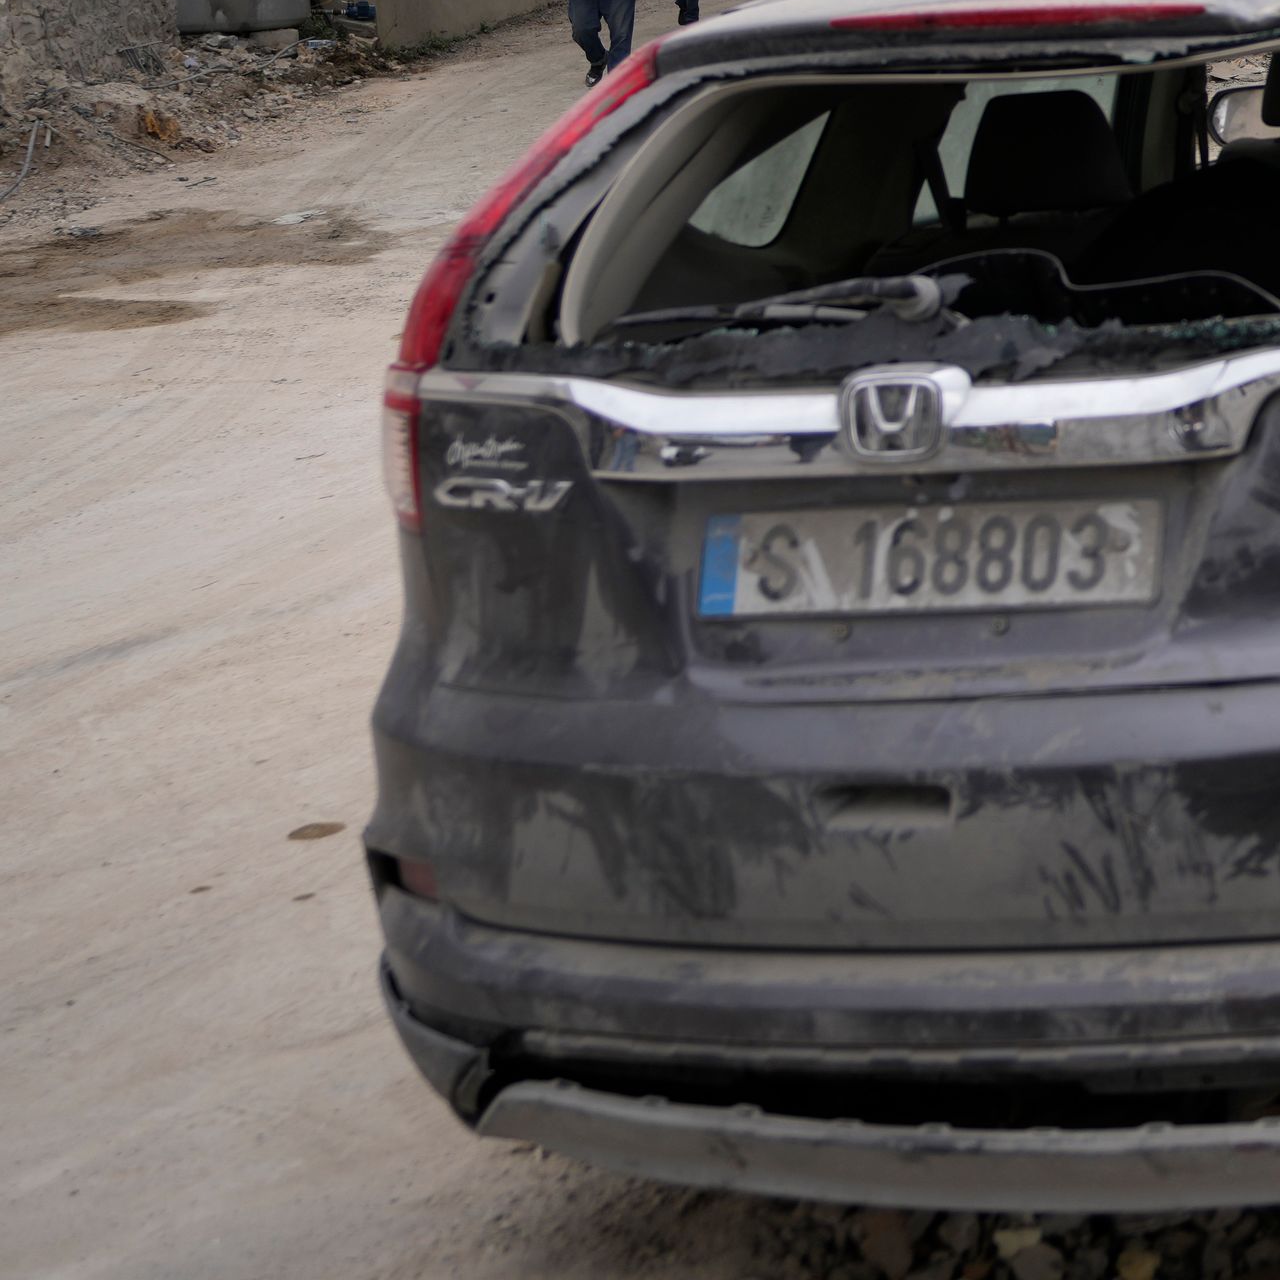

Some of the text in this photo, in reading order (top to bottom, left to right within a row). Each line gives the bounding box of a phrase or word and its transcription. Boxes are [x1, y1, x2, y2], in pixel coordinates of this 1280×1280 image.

[434, 475, 575, 511] CR-V
[757, 513, 1108, 602] S 168803
